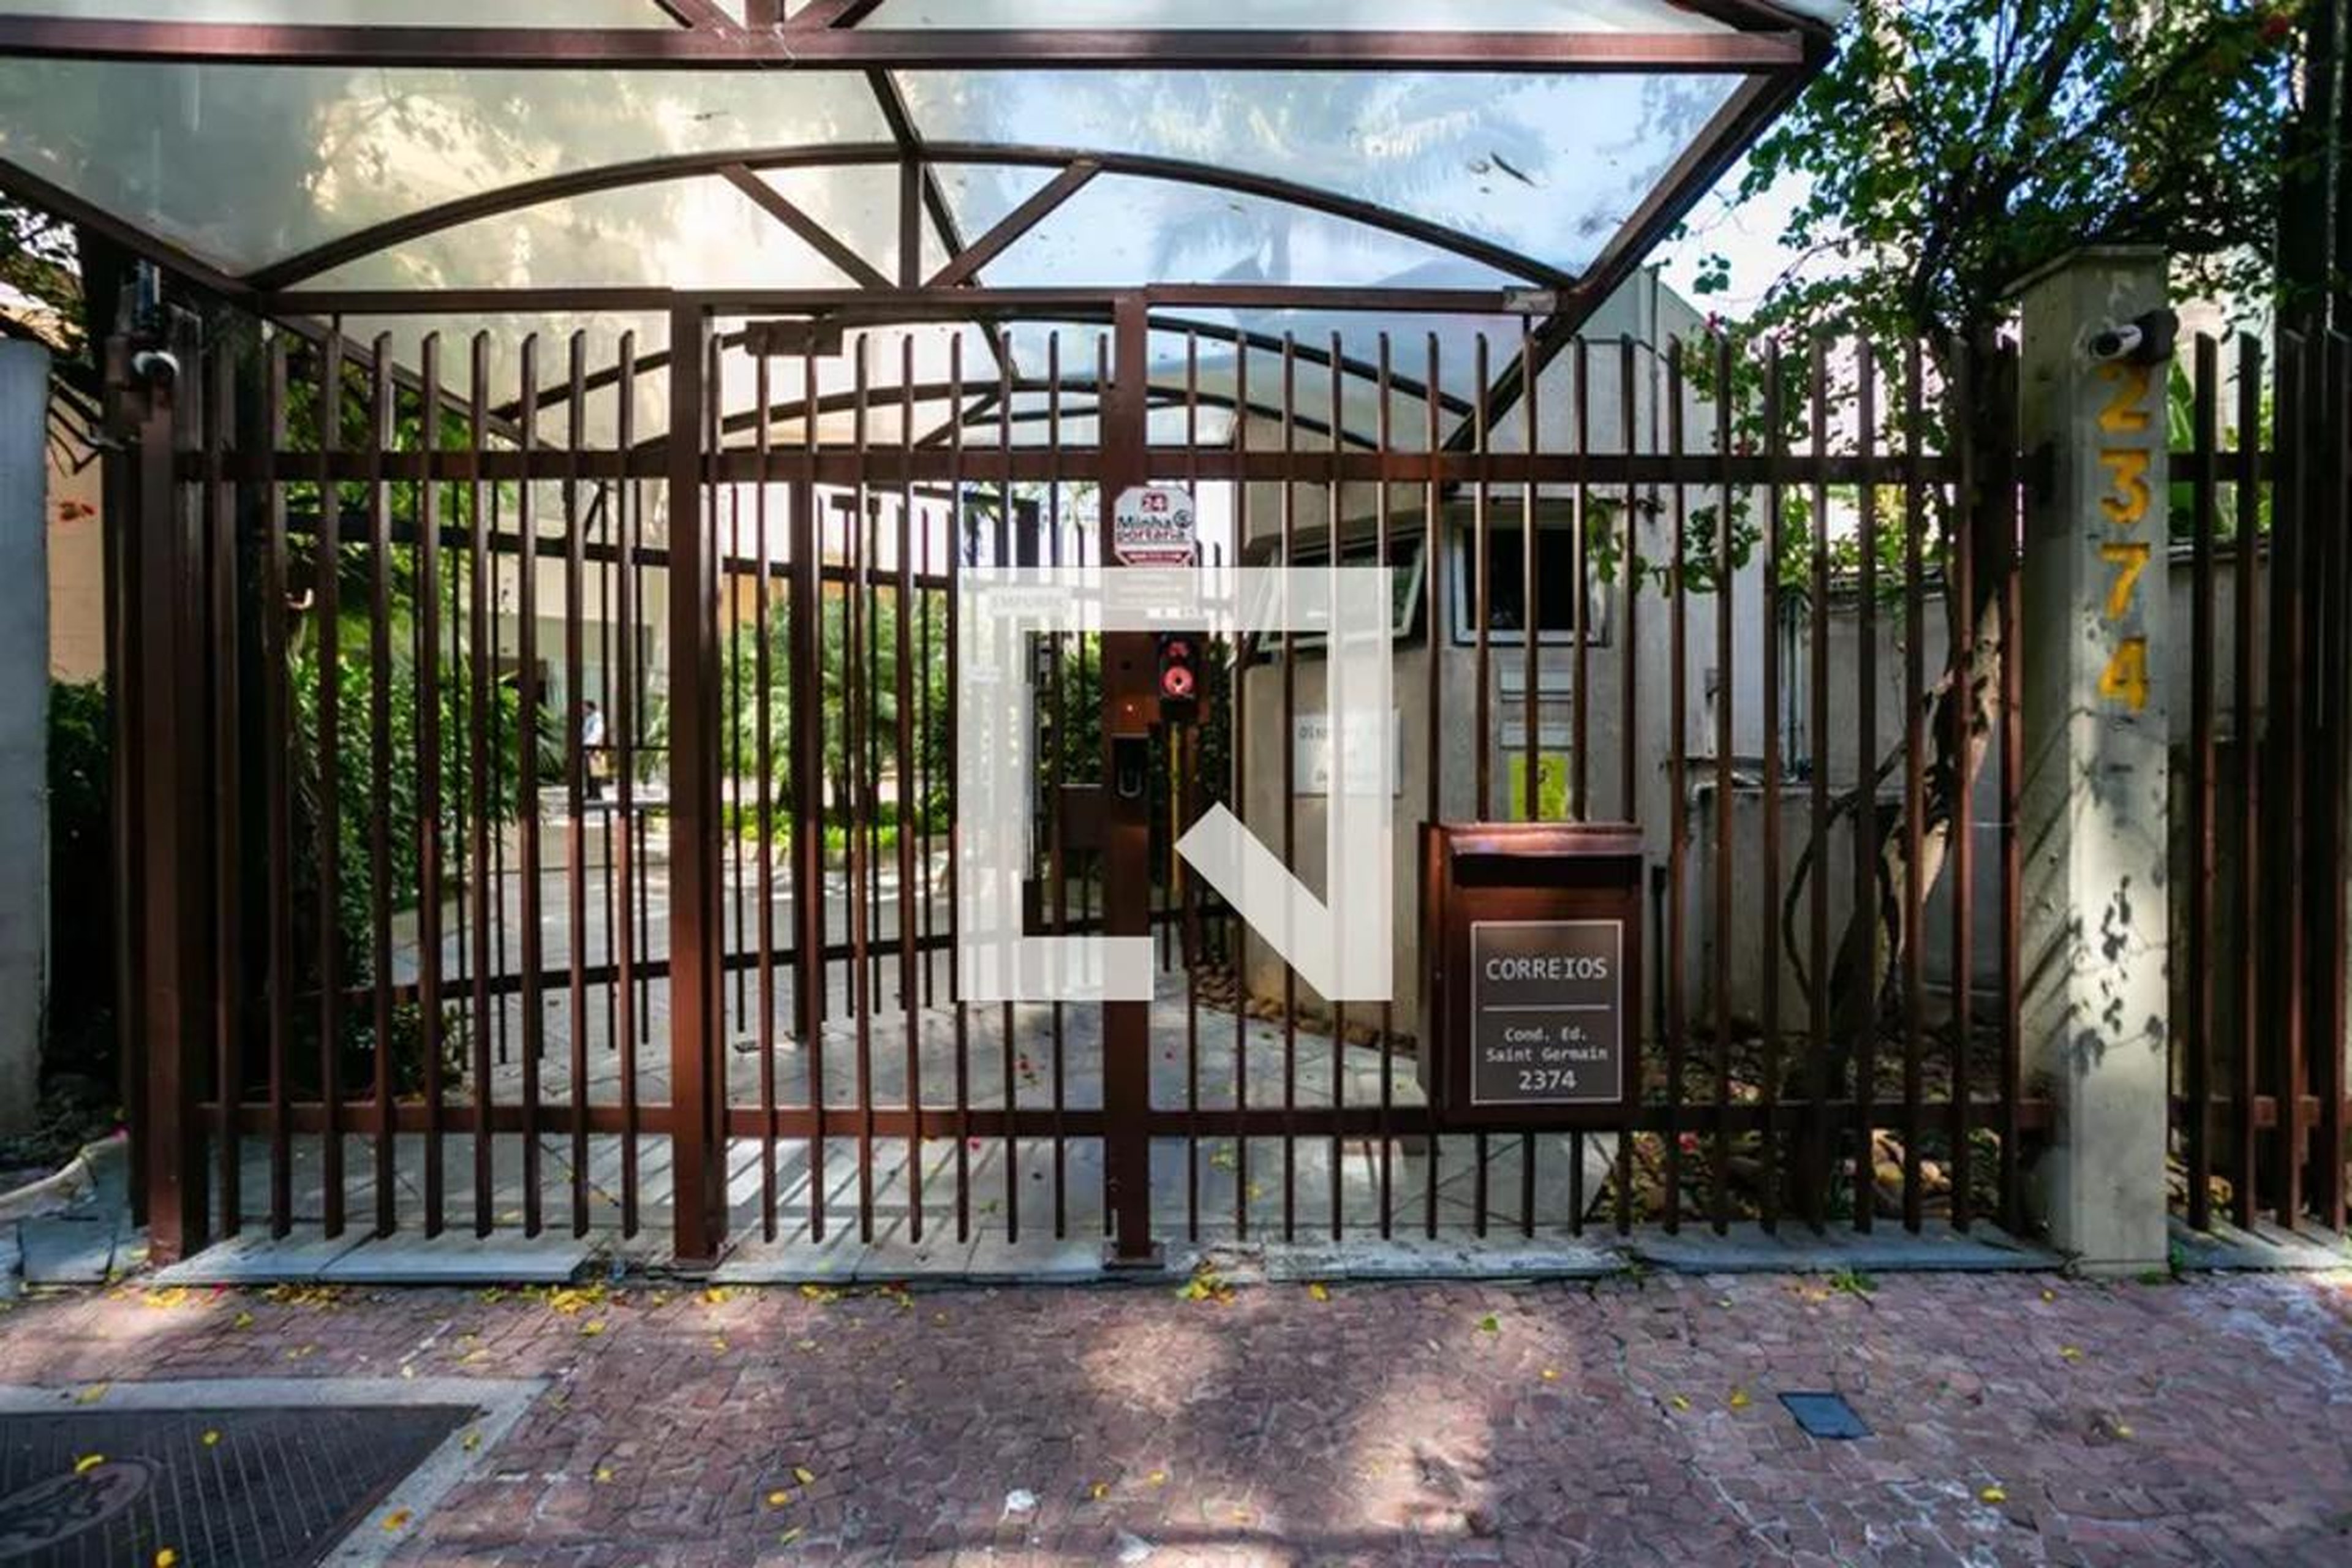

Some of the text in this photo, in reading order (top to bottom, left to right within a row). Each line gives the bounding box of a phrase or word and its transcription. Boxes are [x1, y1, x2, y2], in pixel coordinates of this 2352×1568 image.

[1118, 515, 1172, 529] Minha
[2096, 360, 2151, 715] 2374
[1486, 957, 1608, 980] CORREIOS
[1505, 1027, 1586, 1042] Cond. Ed.
[1486, 1046, 1608, 1062] Saint Germain
[1519, 1069, 1577, 1091] 2374
